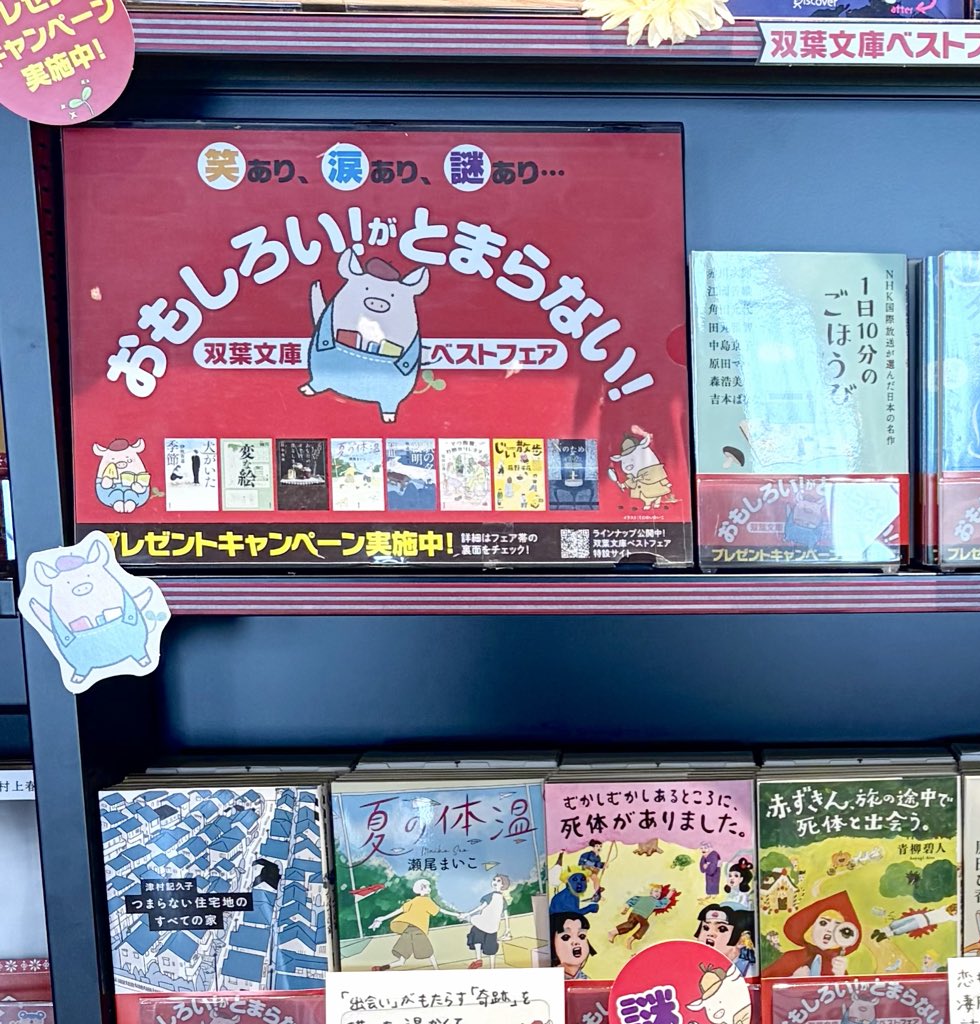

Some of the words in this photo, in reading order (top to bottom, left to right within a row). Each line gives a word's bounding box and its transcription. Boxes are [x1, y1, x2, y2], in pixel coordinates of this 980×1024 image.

[20, 38, 107, 94] 実施中!
[106, 206, 655, 401] おもしろい!がとまらない!
[856, 276, 879, 385] 1日10分の
[203, 342, 303, 366] 双葉文庫
[429, 343, 559, 366] ベストフェア
[823, 288, 858, 407] ごほうび
[884, 268, 896, 447] NHK国際放送が選んだ日本の名作
[237, 443, 256, 488] 変な絵
[460, 533, 538, 545] 詳細はフェア帯の
[592, 539, 672, 550] 双葉文庫ベストフェア
[563, 788, 739, 812] むかしむかしあるところに、
[765, 786, 955, 820] 赤ずきん、旅の途中で
[359, 797, 539, 860] 夏の体温
[559, 809, 746, 839] 死体がありました。
[797, 812, 930, 838] 死体と出会う。
[897, 841, 947, 857] 青柳碧人
[407, 855, 480, 873] 瀬尾まいこ
[144, 881, 194, 894] 津村記久子
[131, 895, 249, 911] つまらない住宅地の
[154, 913, 219, 928] すべての家
